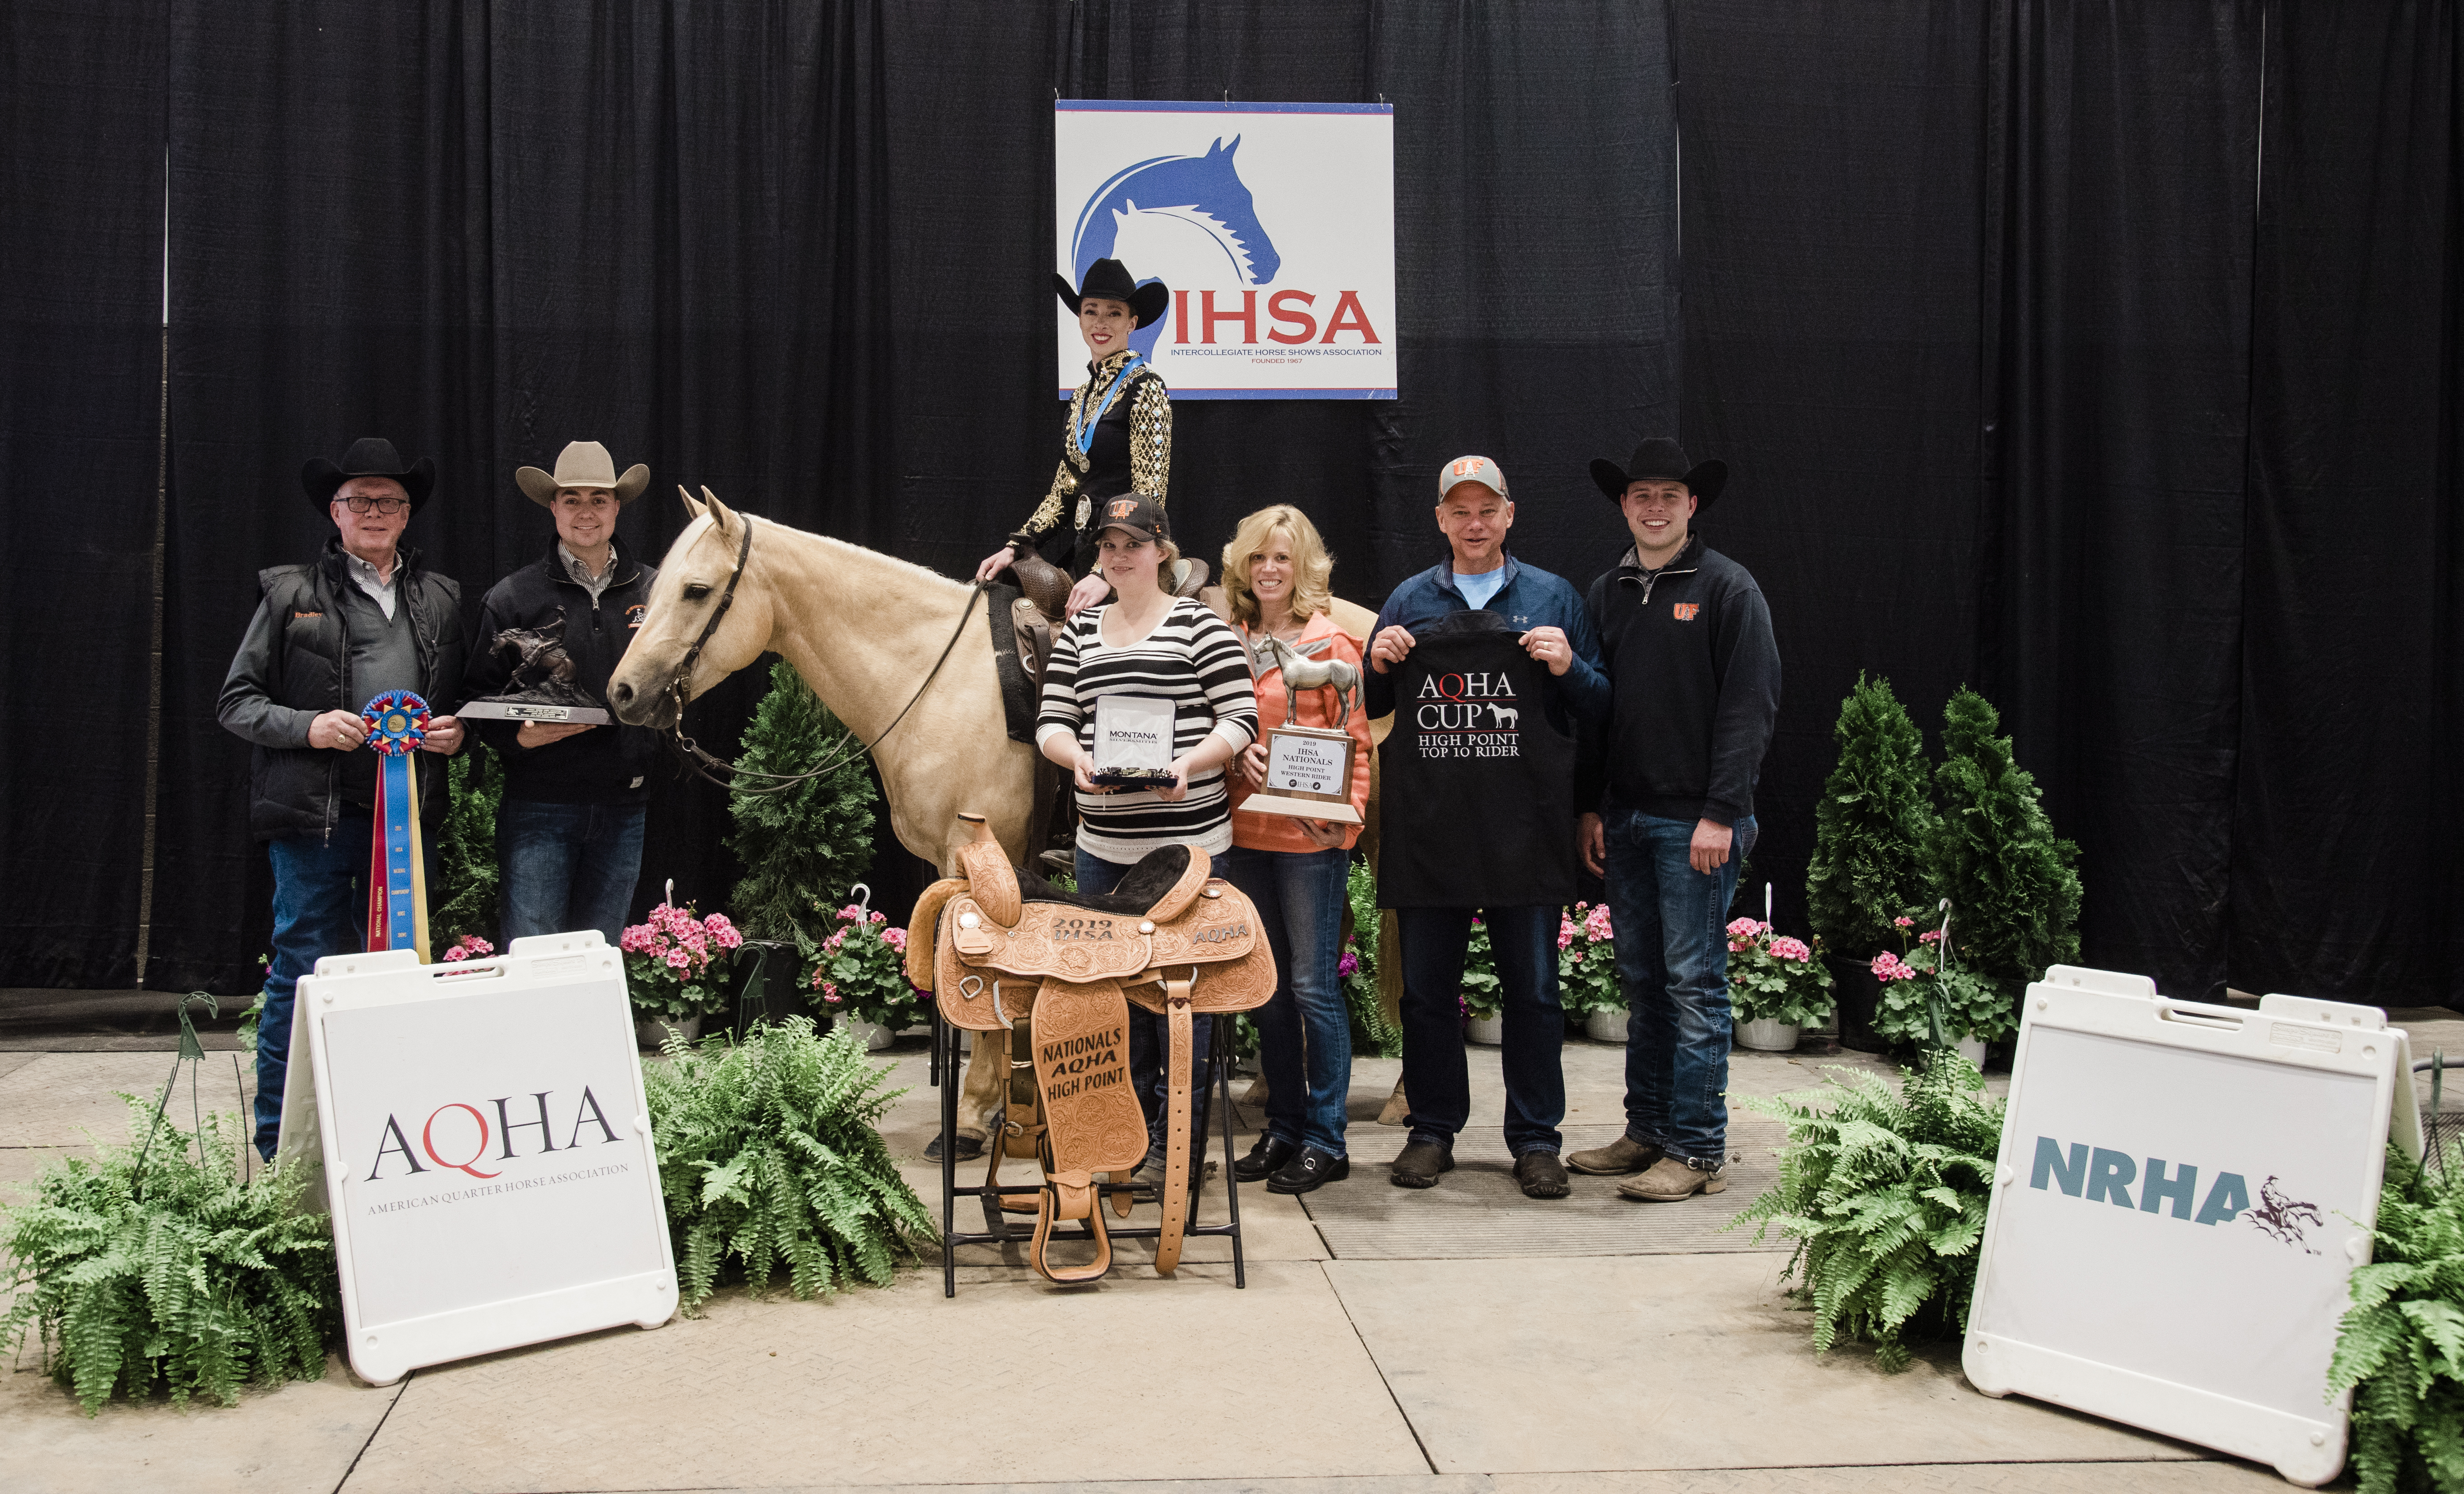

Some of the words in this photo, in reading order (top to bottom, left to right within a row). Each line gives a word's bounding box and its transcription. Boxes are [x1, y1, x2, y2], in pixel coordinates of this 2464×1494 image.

[1173, 289, 1382, 344] IHSA
[1417, 672, 1516, 703] AQHA
[1417, 704, 1482, 730] CUP
[1110, 731, 1157, 740] MONTANA
[1418, 734, 1461, 746] HIGH
[1468, 733, 1519, 745] POINT
[1282, 754, 1333, 766] NATIONALS
[1298, 748, 1319, 756] IHSA
[1419, 747, 1448, 758] TOP
[1453, 747, 1470, 757] 10
[1475, 746, 1520, 757] RIDER
[1053, 918, 1112, 930] 2019
[1054, 930, 1113, 941] IHSA
[1192, 924, 1248, 944] AQHA
[1043, 1028, 1121, 1064] NATIONALS
[1052, 1050, 1117, 1078] AQHA
[1048, 1077, 1080, 1102] HIGH
[1085, 1067, 1125, 1091] POINT
[364, 1085, 624, 1182] AQHA
[368, 1194, 440, 1215] AMERICAN
[442, 1184, 502, 1204] QUARTER
[505, 1177, 546, 1192] HORSE
[548, 1163, 629, 1185] ASSOCIATION
[2029, 1136, 2250, 1226] NRHA
